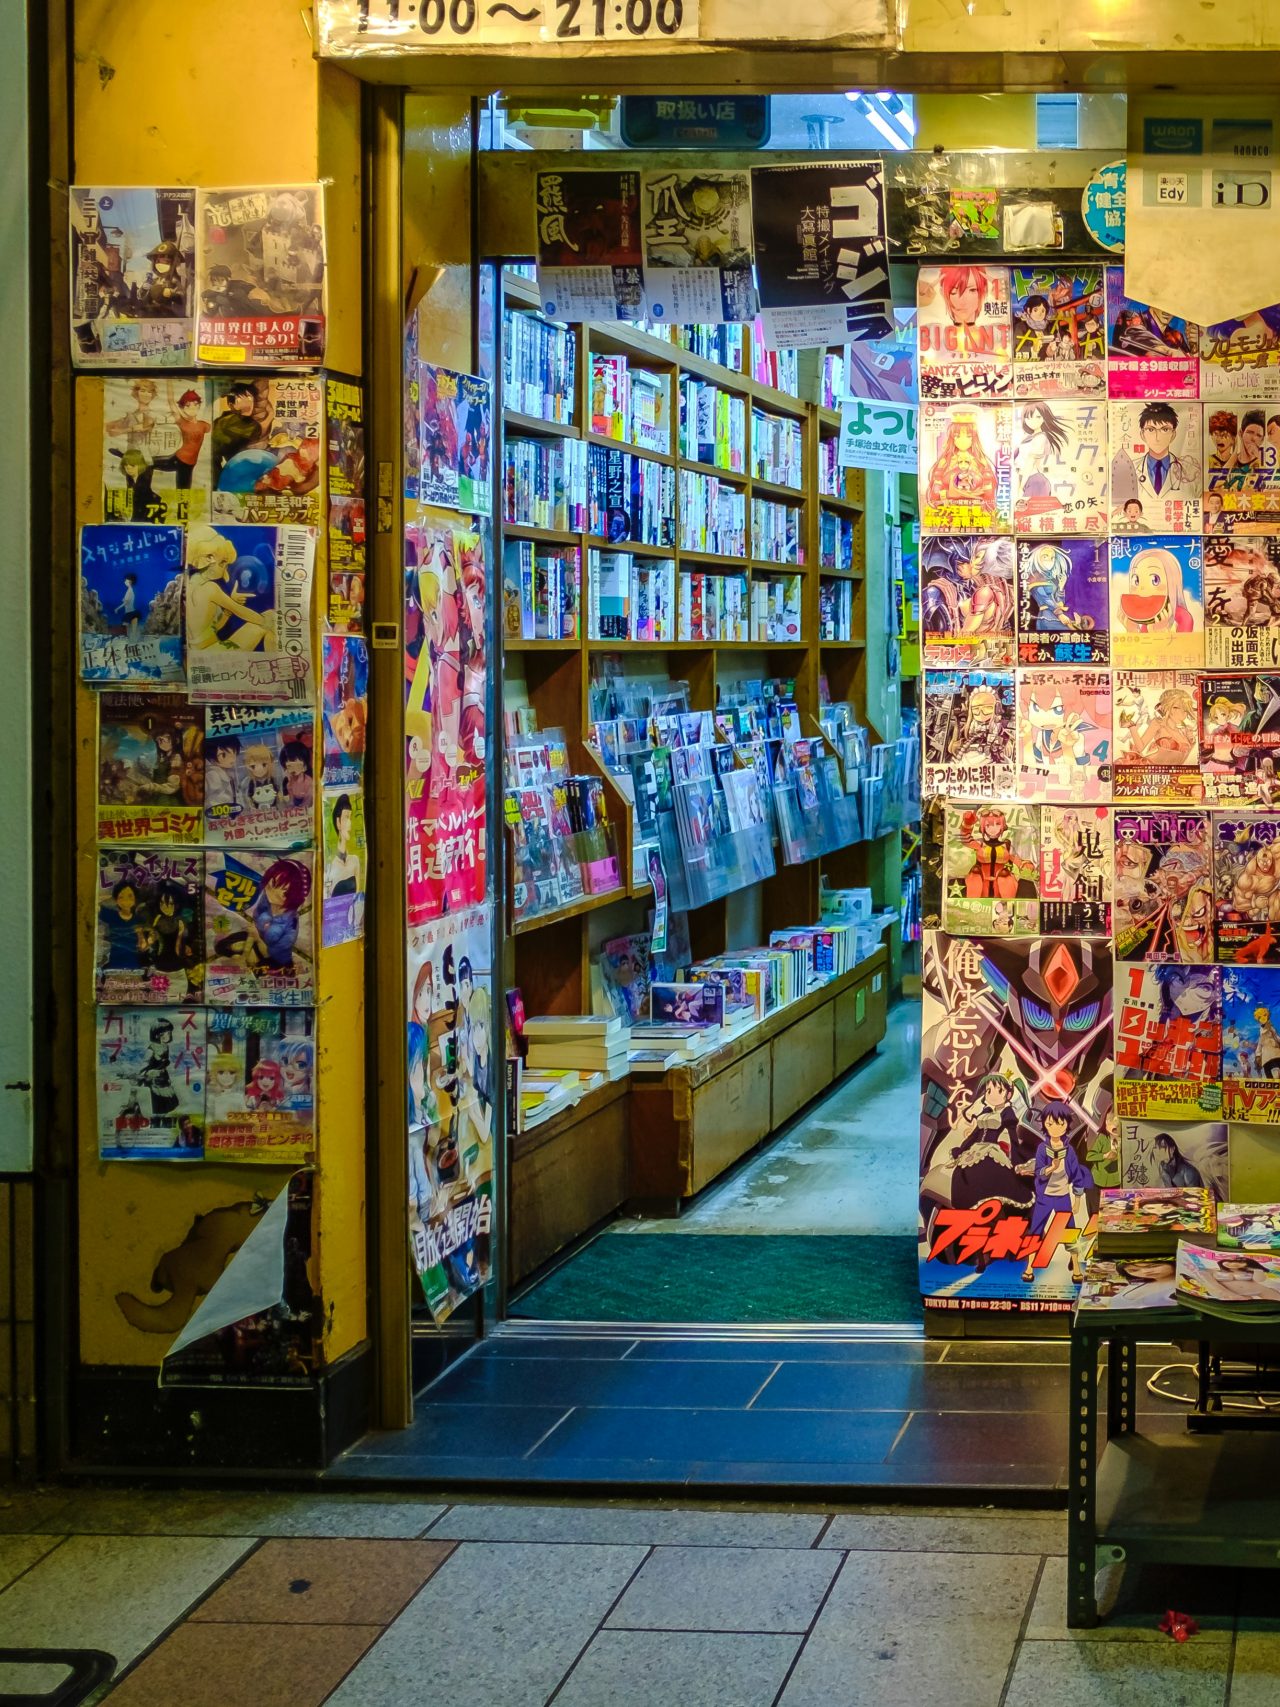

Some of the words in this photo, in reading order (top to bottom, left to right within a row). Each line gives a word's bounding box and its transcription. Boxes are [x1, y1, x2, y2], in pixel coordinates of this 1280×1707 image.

[1160, 187, 1185, 201] Edy
[1215, 182, 1269, 207] iD
[1257, 446, 1277, 467] 13
